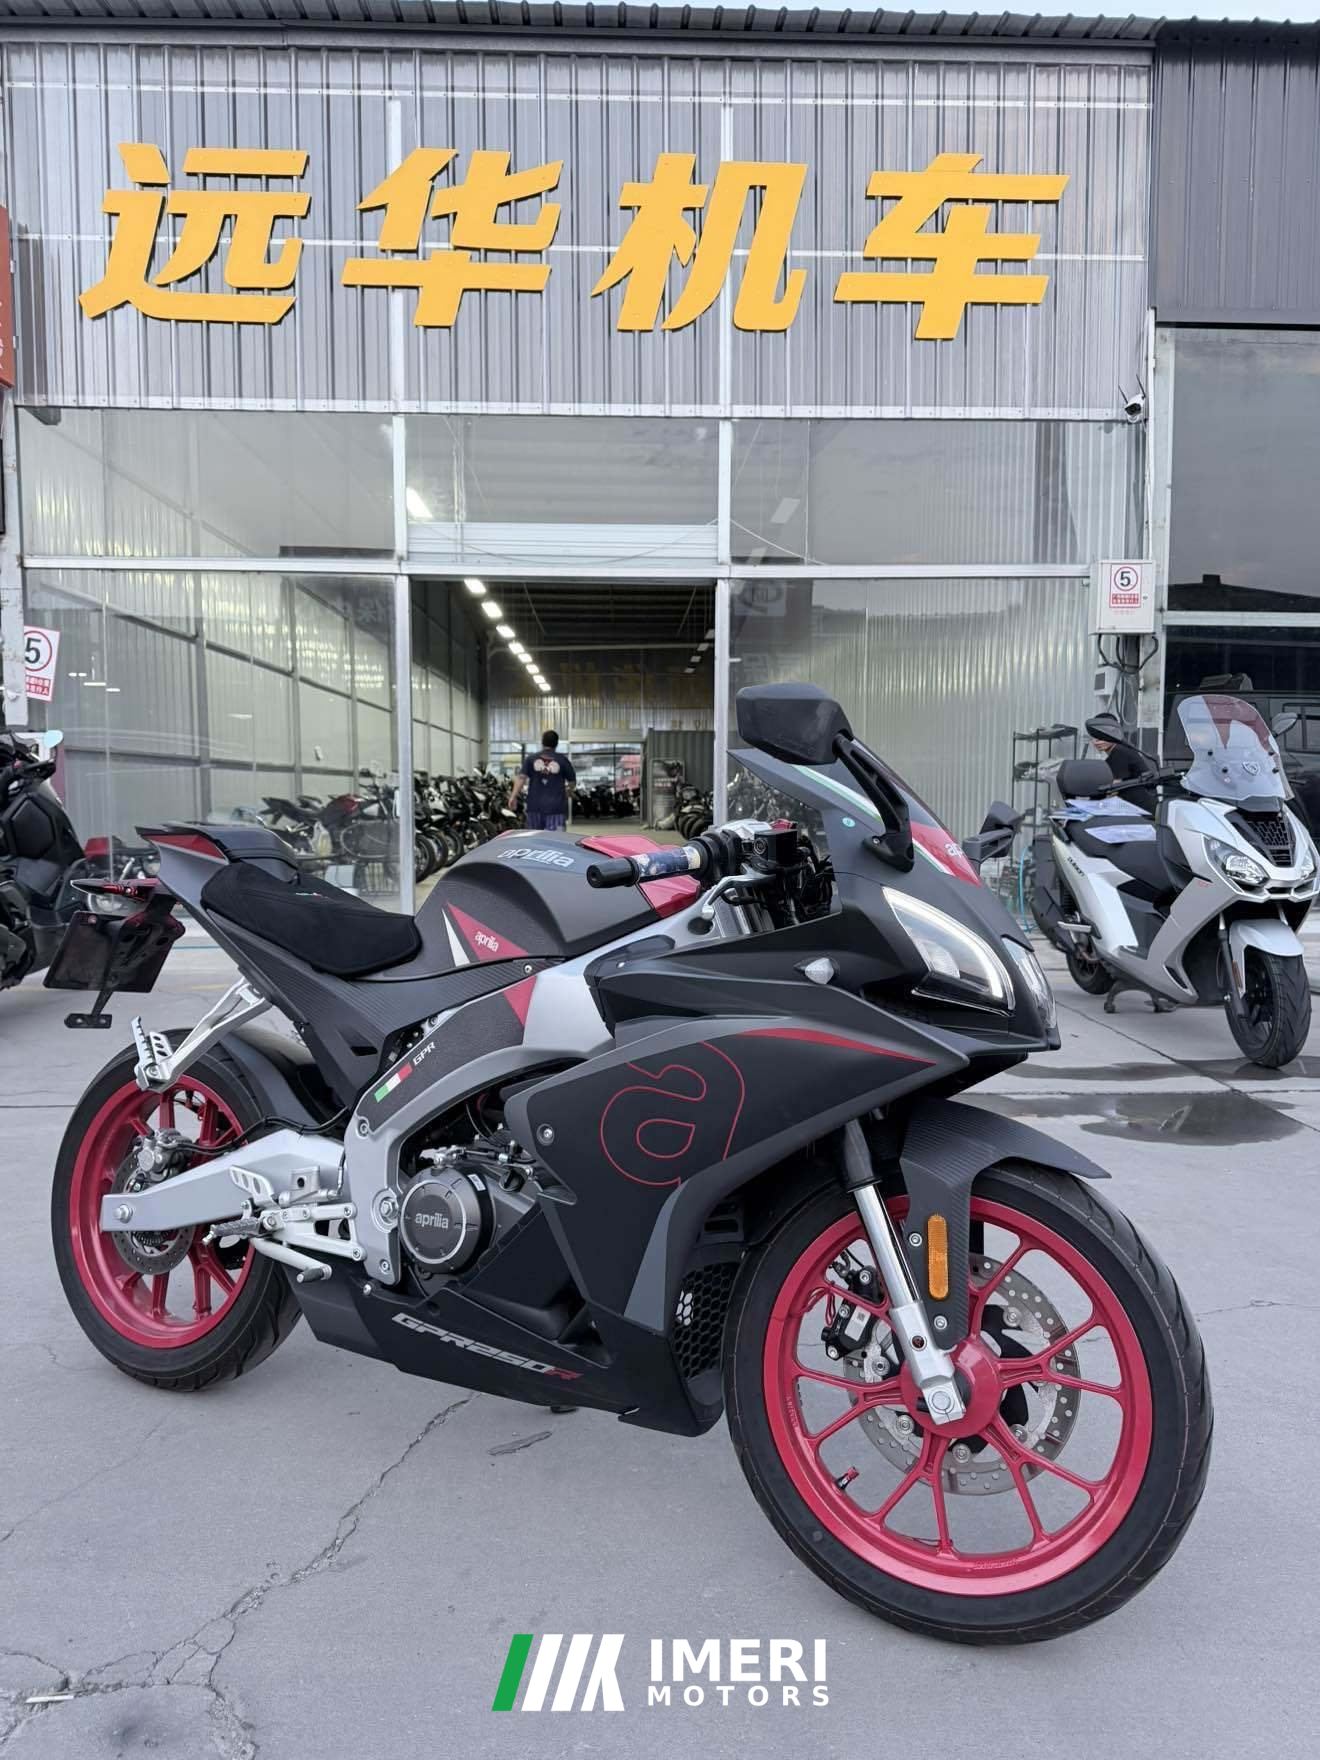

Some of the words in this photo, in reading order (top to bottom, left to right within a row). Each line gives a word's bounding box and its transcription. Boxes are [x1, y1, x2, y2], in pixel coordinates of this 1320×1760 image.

[79, 143, 1070, 340] 远华机车
[1120, 571, 1131, 587] 5
[25, 637, 42, 664] 5
[497, 848, 575, 868] aprilia
[412, 1041, 437, 1067] GPR
[415, 1211, 450, 1230] aprilia
